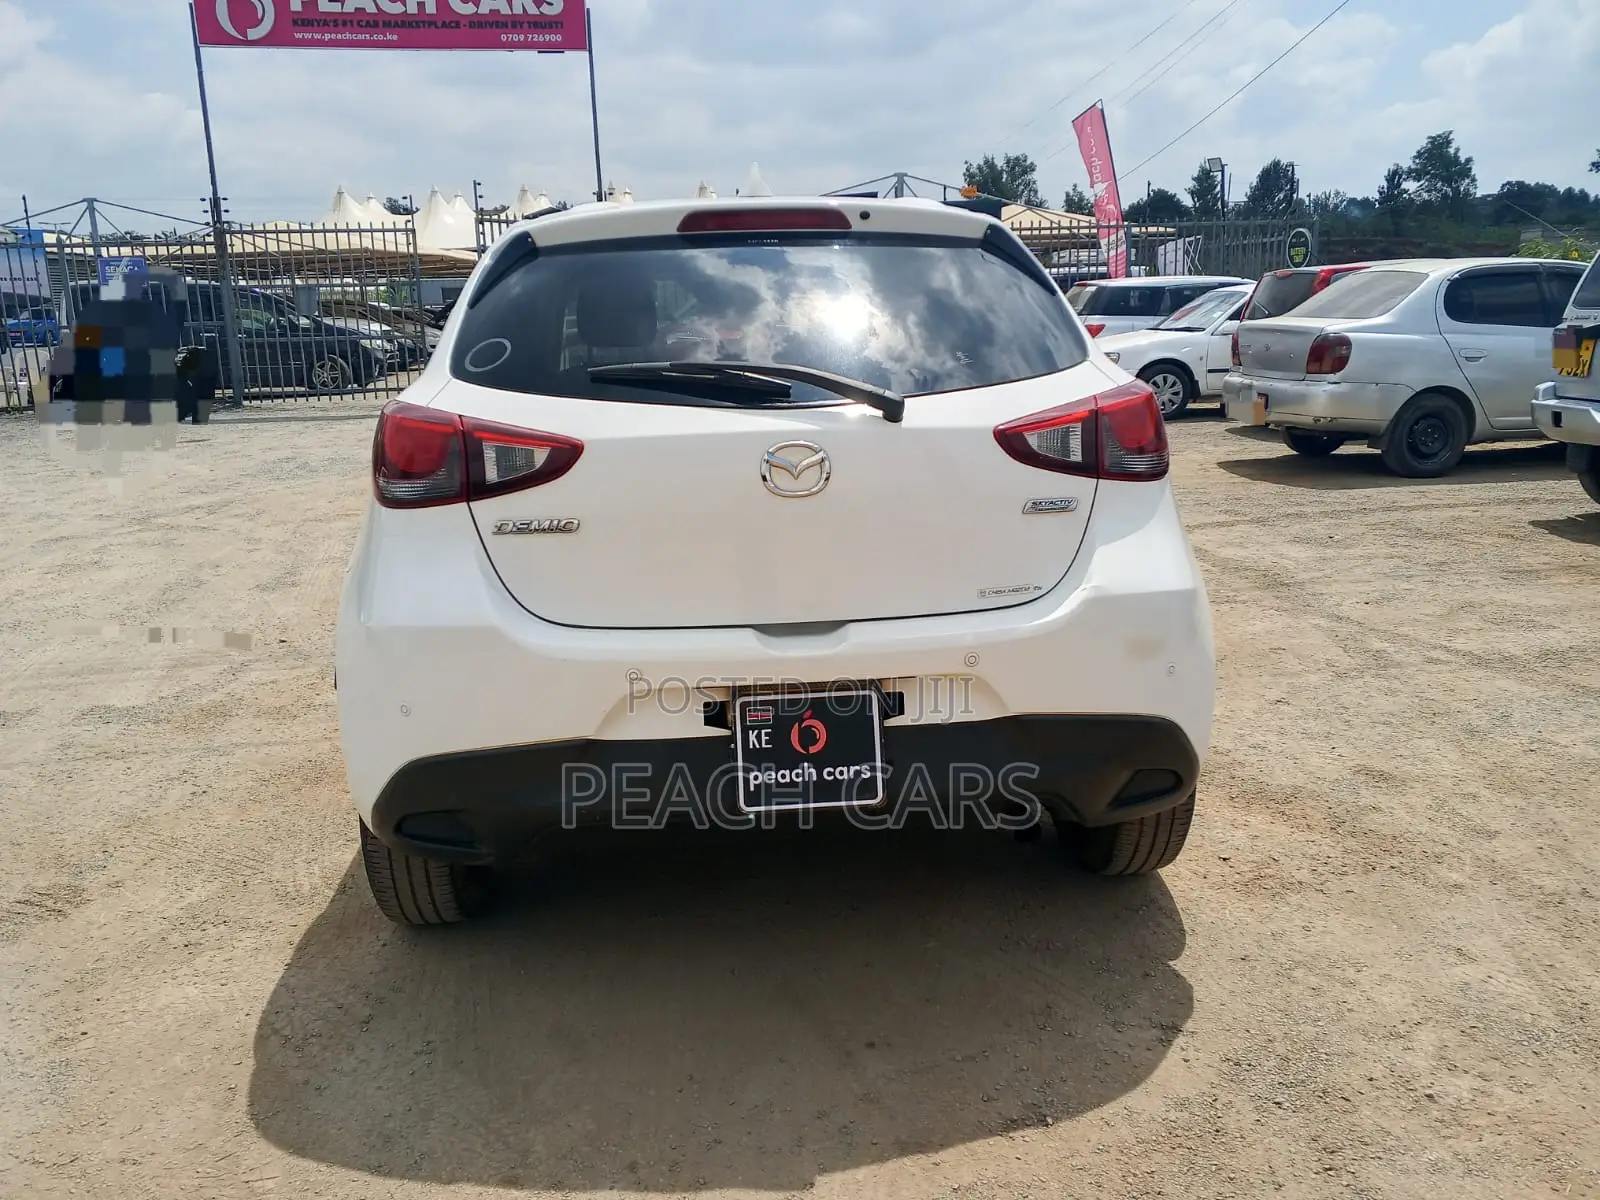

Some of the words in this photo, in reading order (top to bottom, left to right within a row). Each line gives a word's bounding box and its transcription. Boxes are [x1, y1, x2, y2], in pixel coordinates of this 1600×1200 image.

[292, 18, 338, 28] KENYA'S
[356, 19, 379, 28] CAR
[382, 19, 461, 29] MARKETPLACE
[468, 20, 509, 29] DRIVEN
[511, 21, 525, 29] BY
[526, 20, 564, 30] TRUST!
[294, 32, 398, 41] www.peachcars.co.ke
[500, 33, 525, 42] 0709
[492, 518, 580, 535] DEMIO
[748, 729, 773, 749] KE
[749, 762, 817, 792] peach
[822, 764, 871, 781] cars
